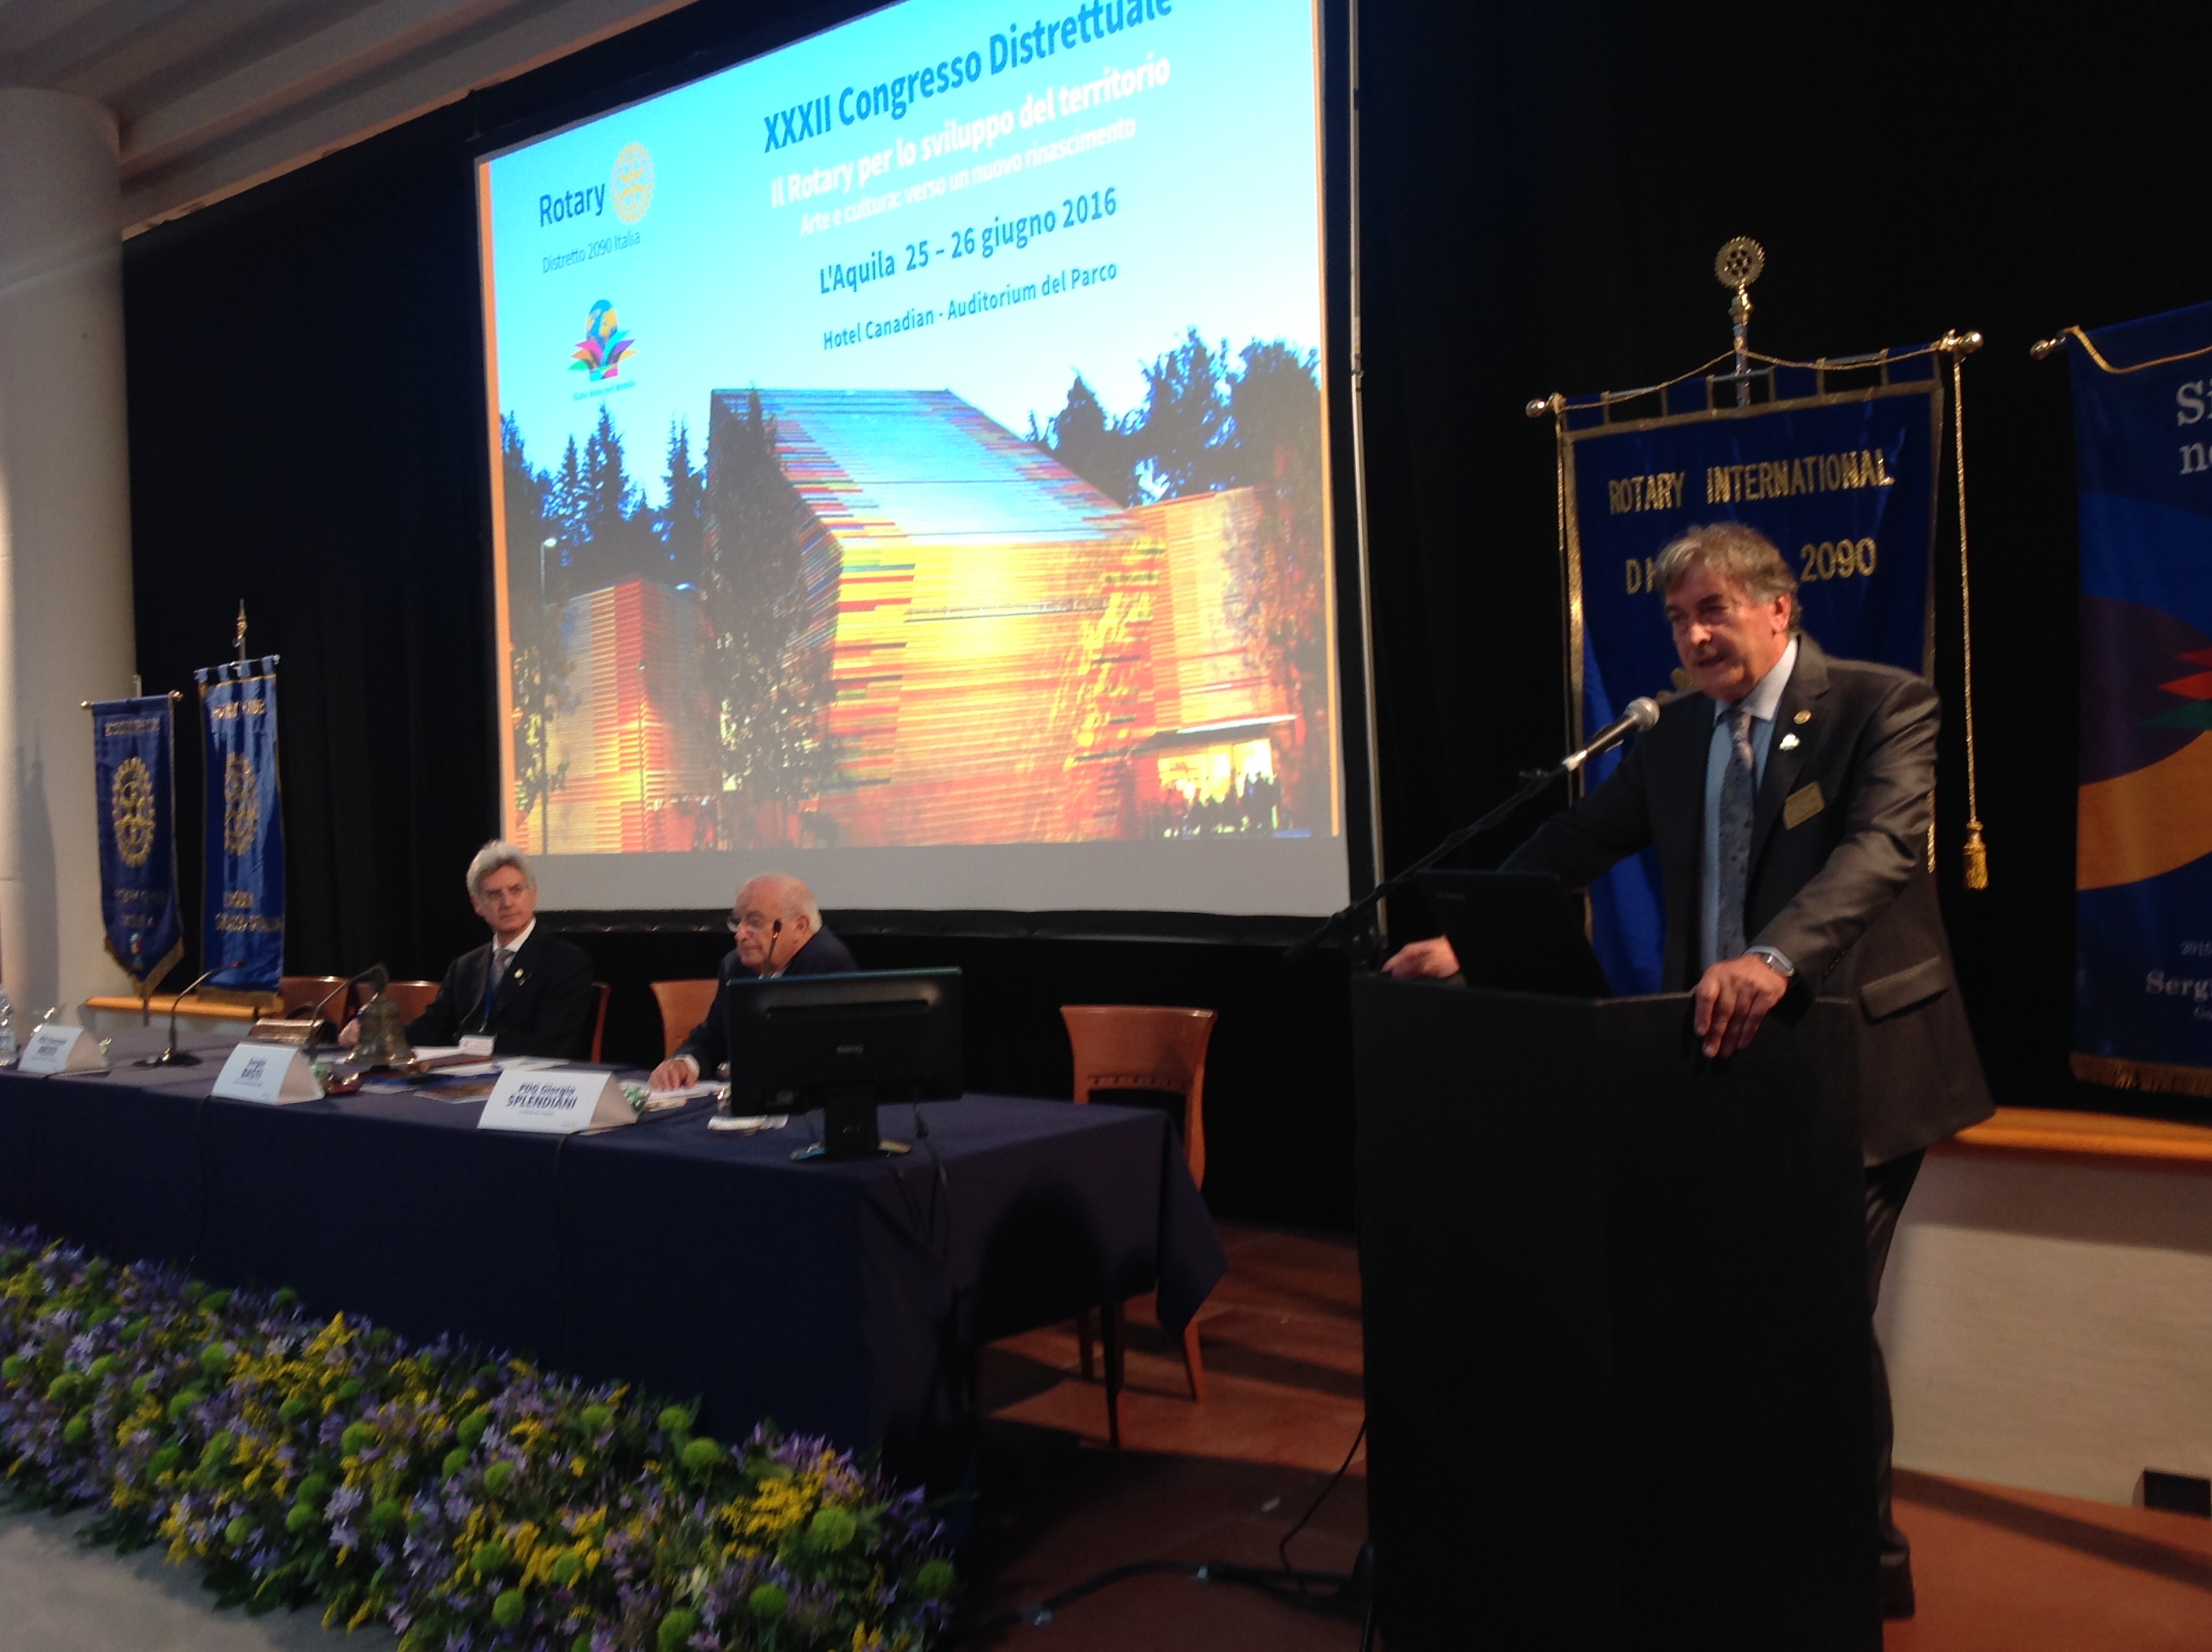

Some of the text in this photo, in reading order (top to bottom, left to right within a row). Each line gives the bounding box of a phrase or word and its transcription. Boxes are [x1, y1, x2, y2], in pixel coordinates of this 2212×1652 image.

[764, 0, 1173, 153] XXXII Congresso Distrettuale
[789, 160, 854, 205] Rotary
[858, 148, 893, 185] per
[896, 137, 916, 168] lo
[921, 119, 1014, 163] sviluppo
[1019, 88, 1055, 129] del
[1058, 52, 1171, 116] territorio
[539, 183, 606, 228] Rotary
[800, 209, 831, 236] Arte
[833, 208, 842, 224] e
[904, 173, 946, 205] verso
[948, 169, 969, 190] un
[971, 154, 1022, 184] nuovo
[1024, 118, 1137, 168] rinascimento
[542, 230, 640, 273] Distretto 2090 Italia
[819, 251, 896, 294] L'Aquila
[905, 240, 929, 272] 25
[952, 228, 975, 259] 26
[981, 210, 1057, 258] giugno
[1062, 187, 1117, 229] 2016
[823, 323, 862, 351] Hotel
[865, 308, 934, 341] Canadian
[947, 284, 1037, 321] Auditorium
[1041, 271, 1066, 297] del
[1070, 262, 1117, 289] Parco
[1609, 448, 1895, 515] ROTARY INTERNATIONAL
[1800, 537, 1877, 583] 2090
[2145, 969, 2212, 1003] Serg
[506, 1093, 578, 1110] SPLENDIANI
